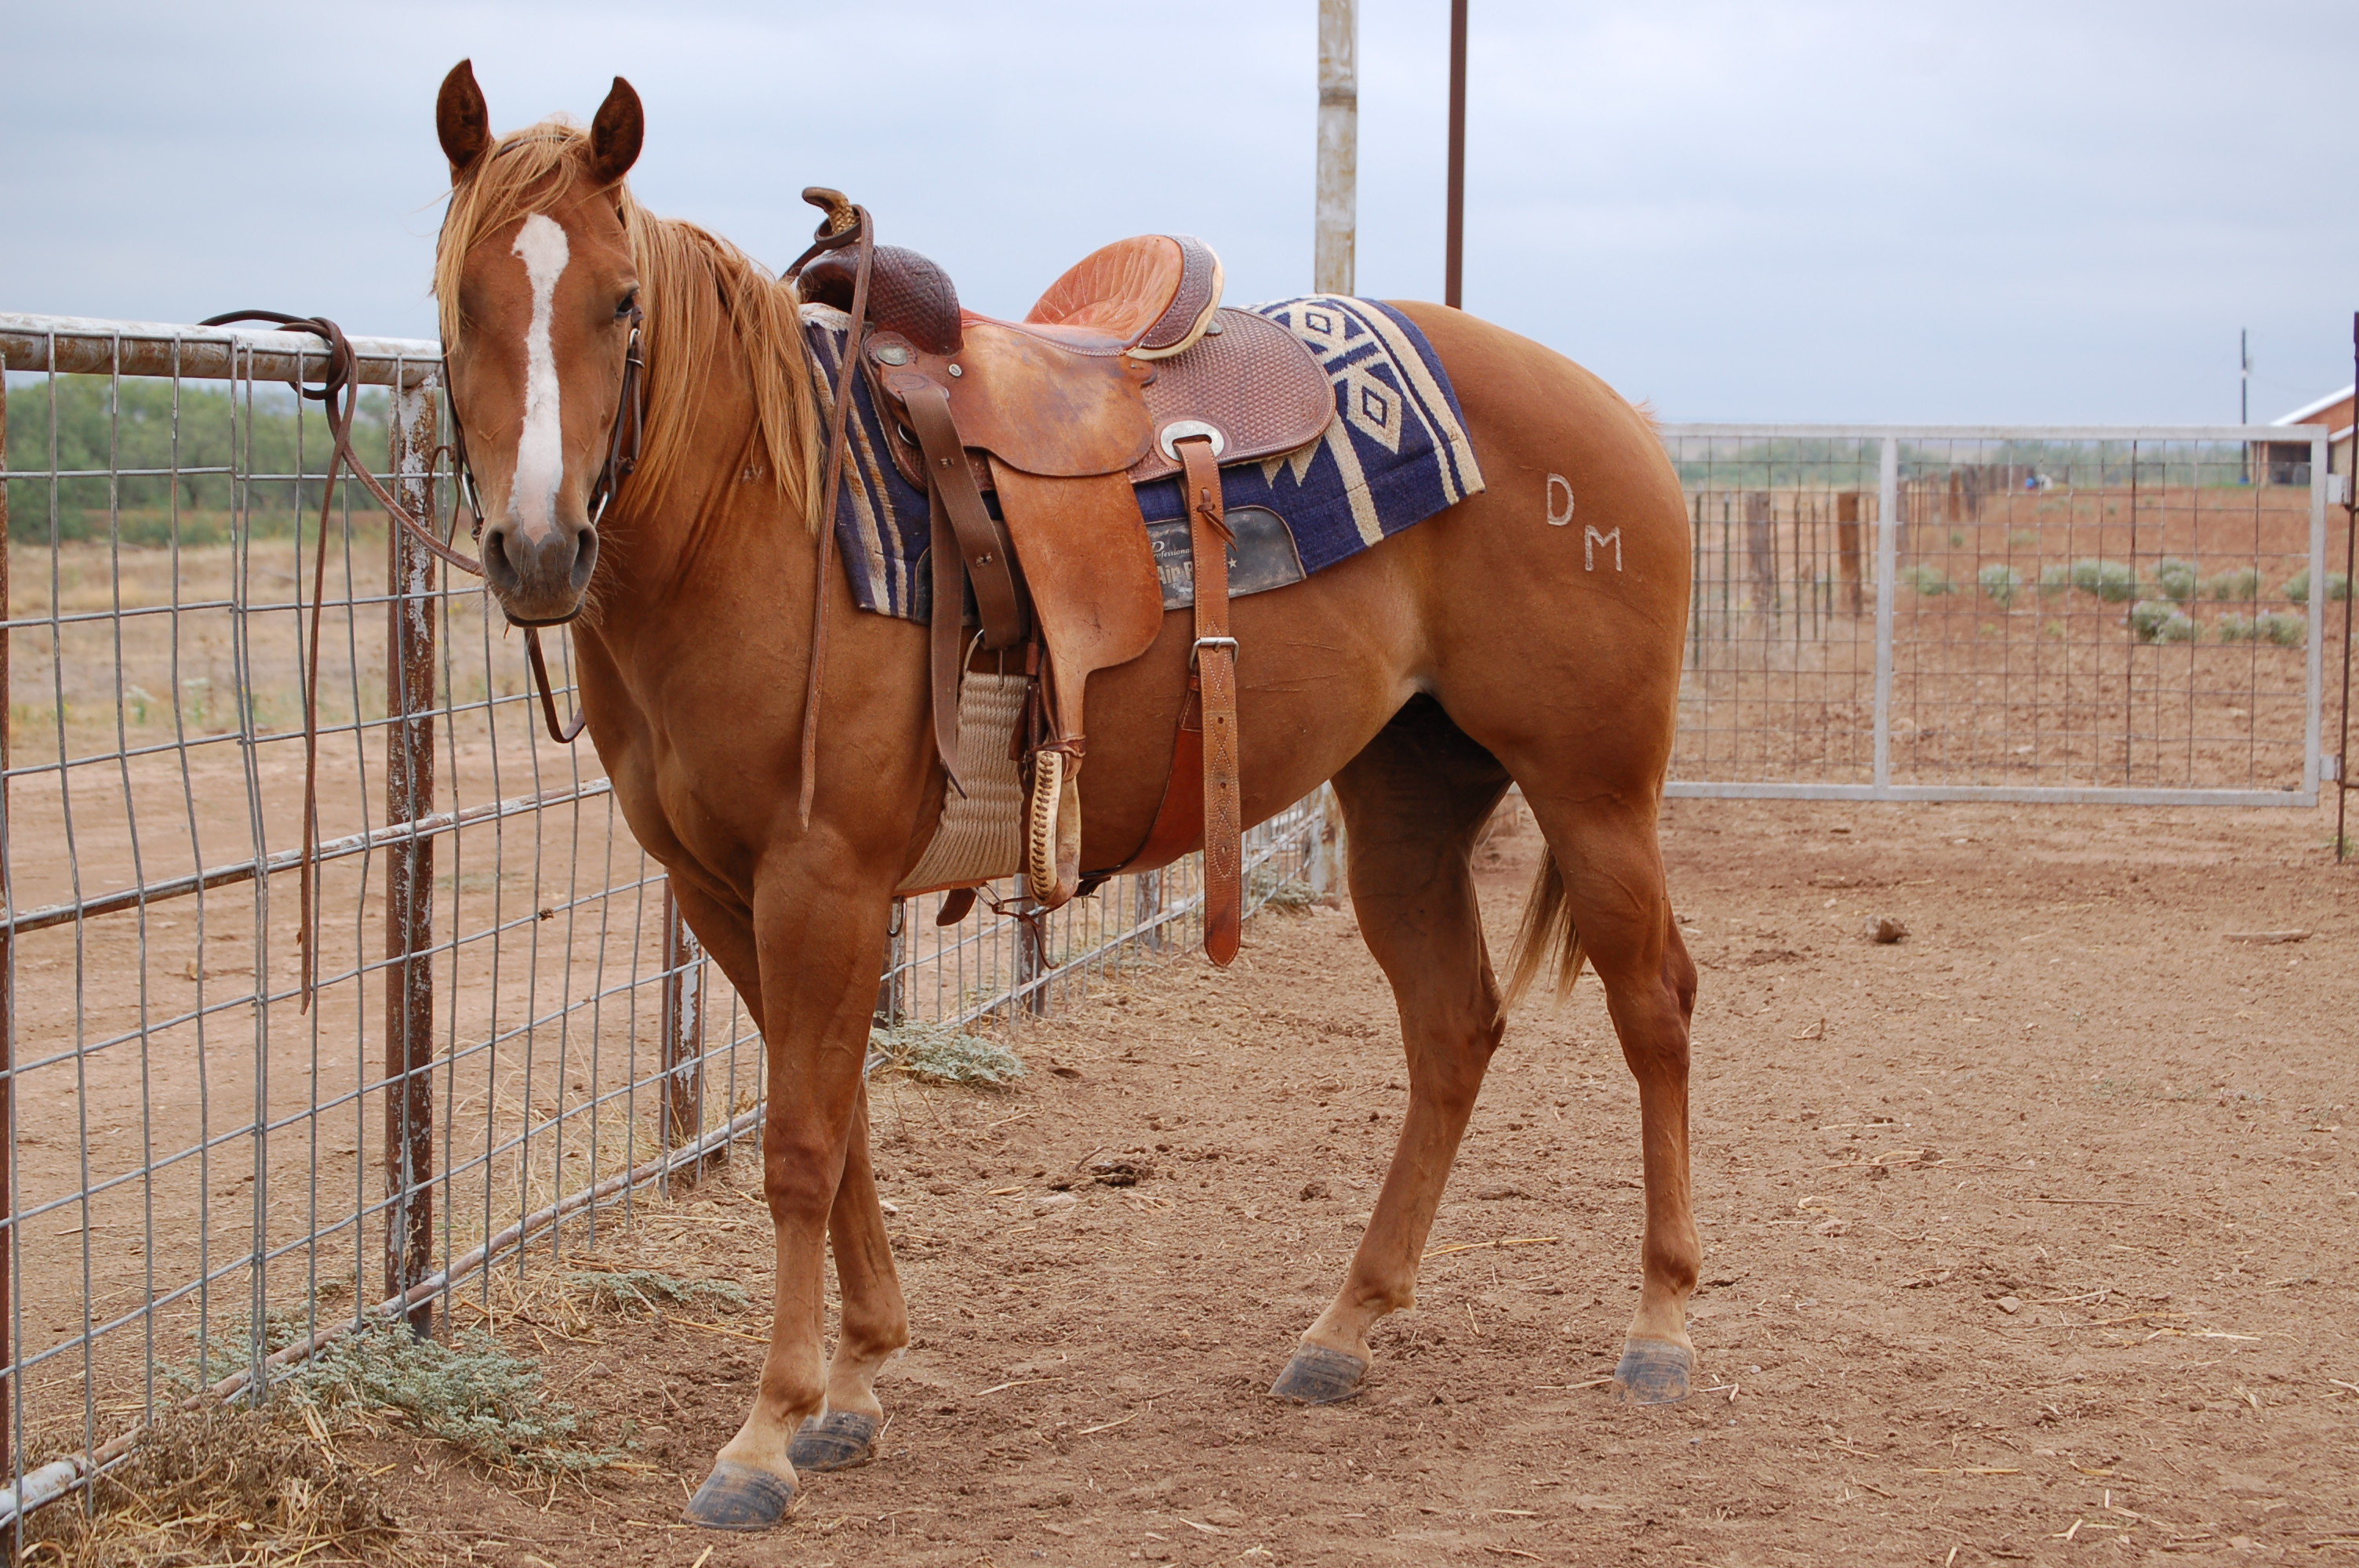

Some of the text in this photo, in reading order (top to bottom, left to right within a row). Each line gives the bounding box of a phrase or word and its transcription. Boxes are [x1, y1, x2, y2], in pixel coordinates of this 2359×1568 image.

[1547, 473, 1574, 526] D
[1183, 561, 1193, 580] R
[1585, 524, 1622, 572] M
